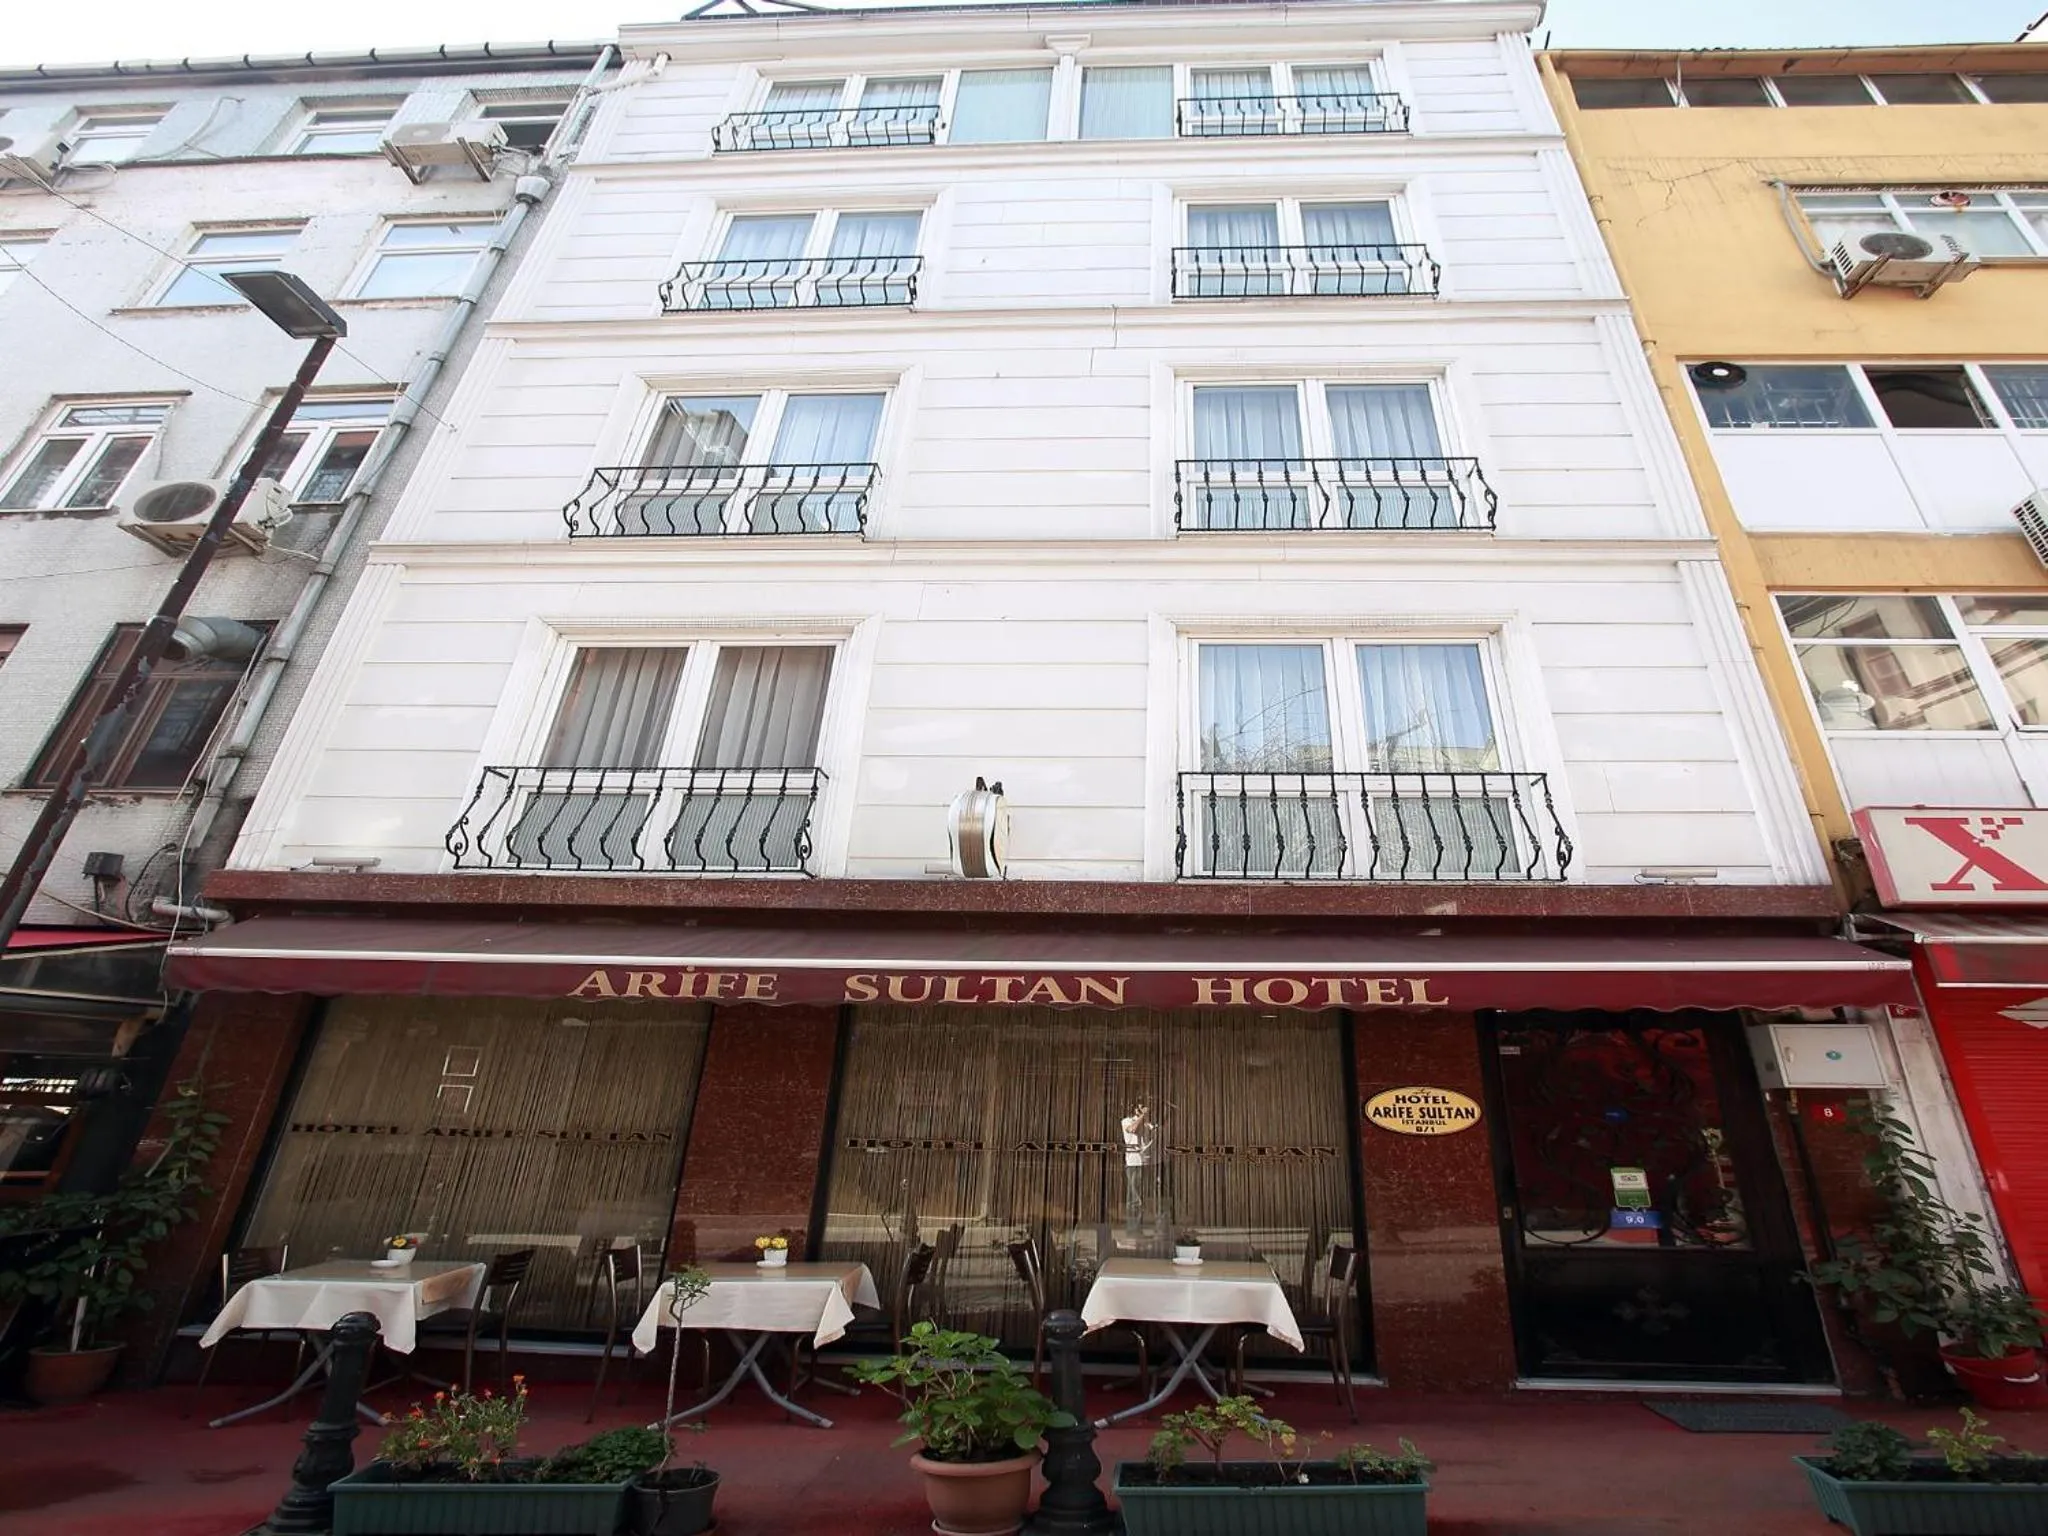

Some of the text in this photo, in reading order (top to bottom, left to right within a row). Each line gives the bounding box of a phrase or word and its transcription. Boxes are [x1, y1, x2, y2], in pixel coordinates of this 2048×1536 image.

[1904, 817, 2048, 891] X
[565, 965, 1449, 1006] ARİFE SULTAN HOTEL
[1395, 1095, 1450, 1104] HOTEL
[1372, 1104, 1476, 1119] ARİFE SULTAN
[292, 1123, 411, 1136] HOTEL
